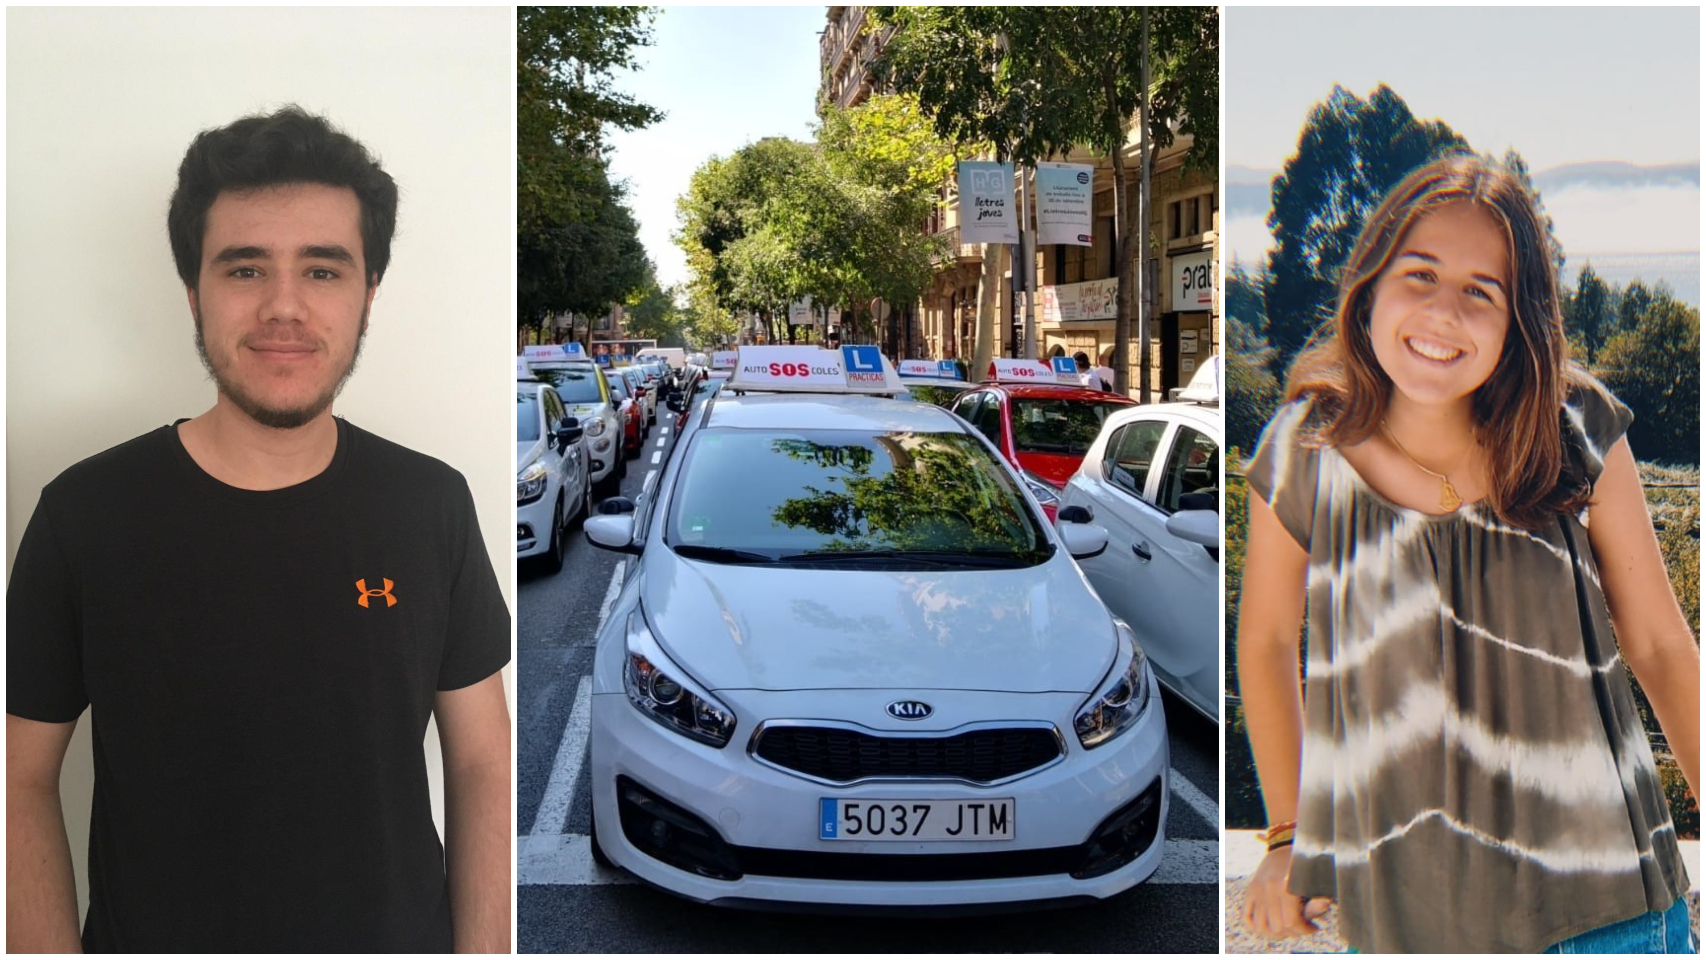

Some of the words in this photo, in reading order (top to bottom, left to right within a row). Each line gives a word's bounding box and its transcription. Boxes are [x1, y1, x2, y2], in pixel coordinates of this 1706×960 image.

[975, 197, 1004, 207] lletres
[977, 208, 1002, 221] joves
[568, 344, 576, 353] L
[852, 350, 874, 369] L
[942, 361, 951, 370] L
[1058, 359, 1072, 372] L
[744, 366, 768, 374] AUTO
[769, 362, 809, 377] SOS
[811, 366, 839, 376] COLES
[1011, 367, 1035, 377] SOS
[848, 372, 885, 381] PRACTICAS
[894, 703, 927, 716] KIA
[843, 803, 932, 837] 5037
[944, 803, 1008, 837] JTM
[825, 822, 834, 833] E
